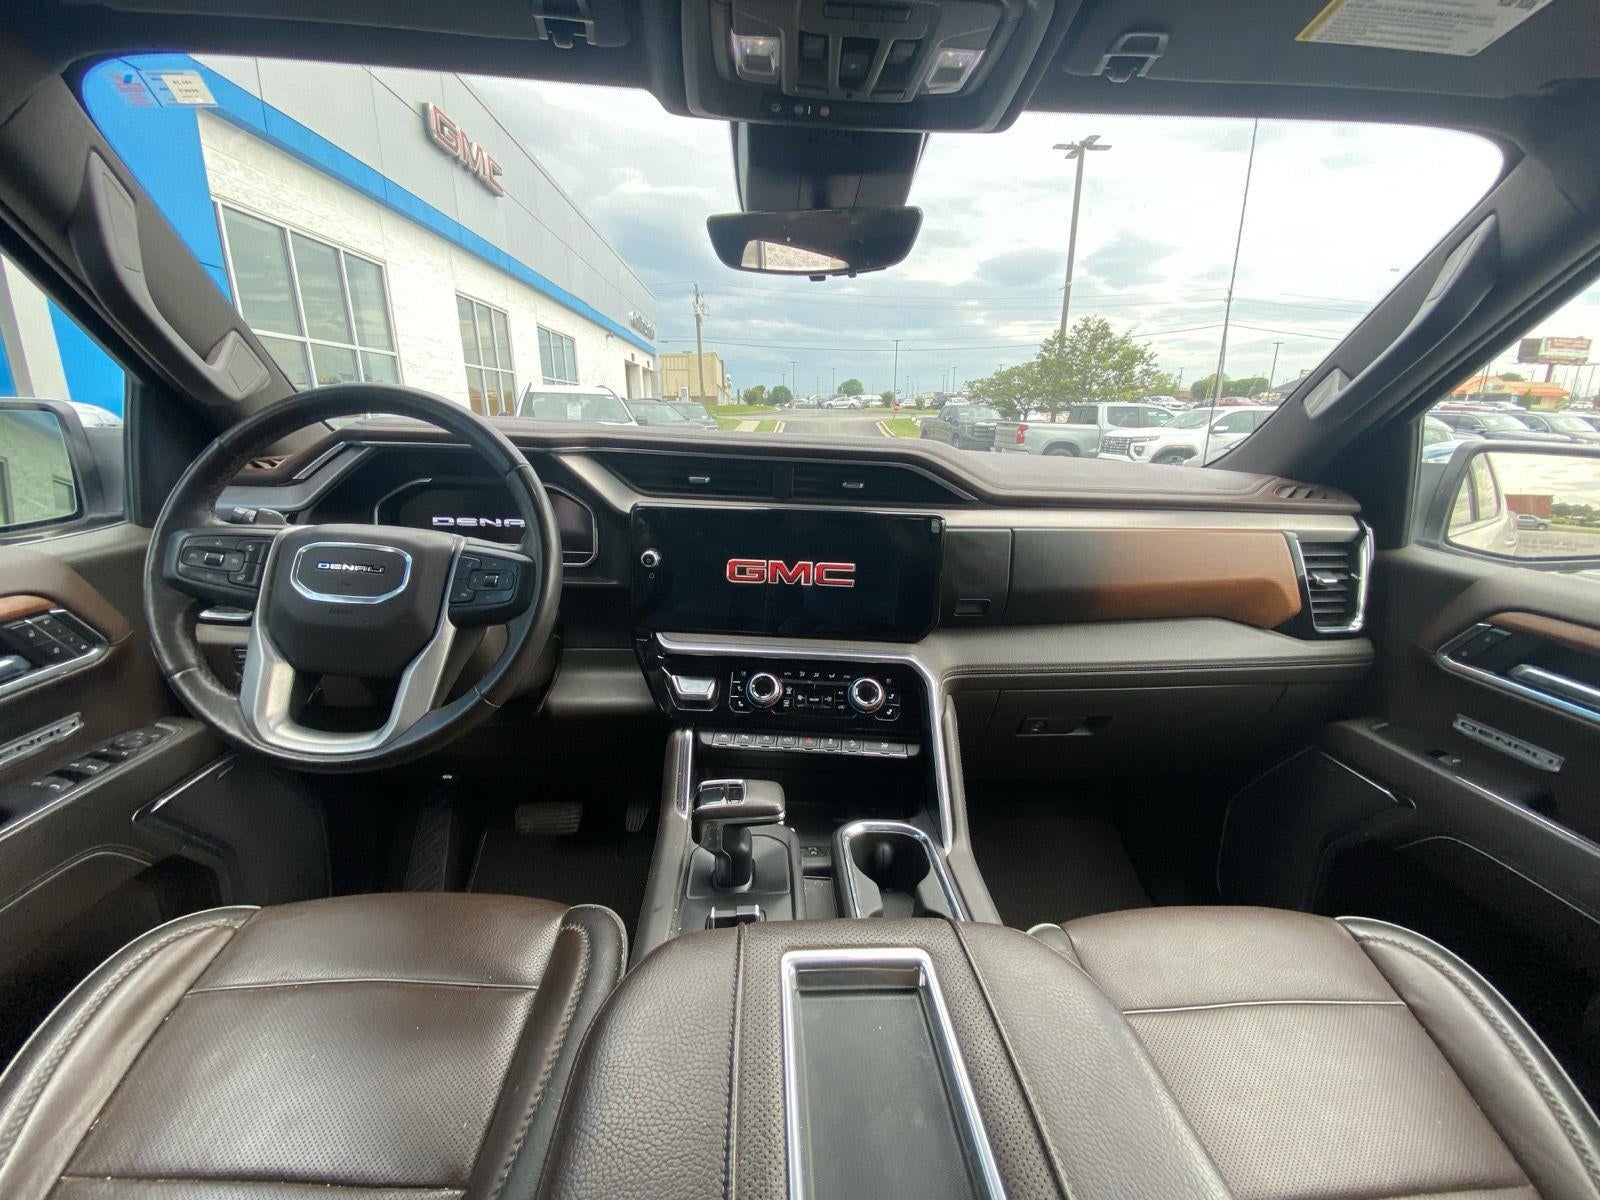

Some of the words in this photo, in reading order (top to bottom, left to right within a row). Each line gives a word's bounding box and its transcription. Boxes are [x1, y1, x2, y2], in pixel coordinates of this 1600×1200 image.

[422, 102, 504, 197] GMC
[432, 516, 525, 528] DENA
[316, 561, 386, 575] DENALI
[726, 559, 856, 588] GMC
